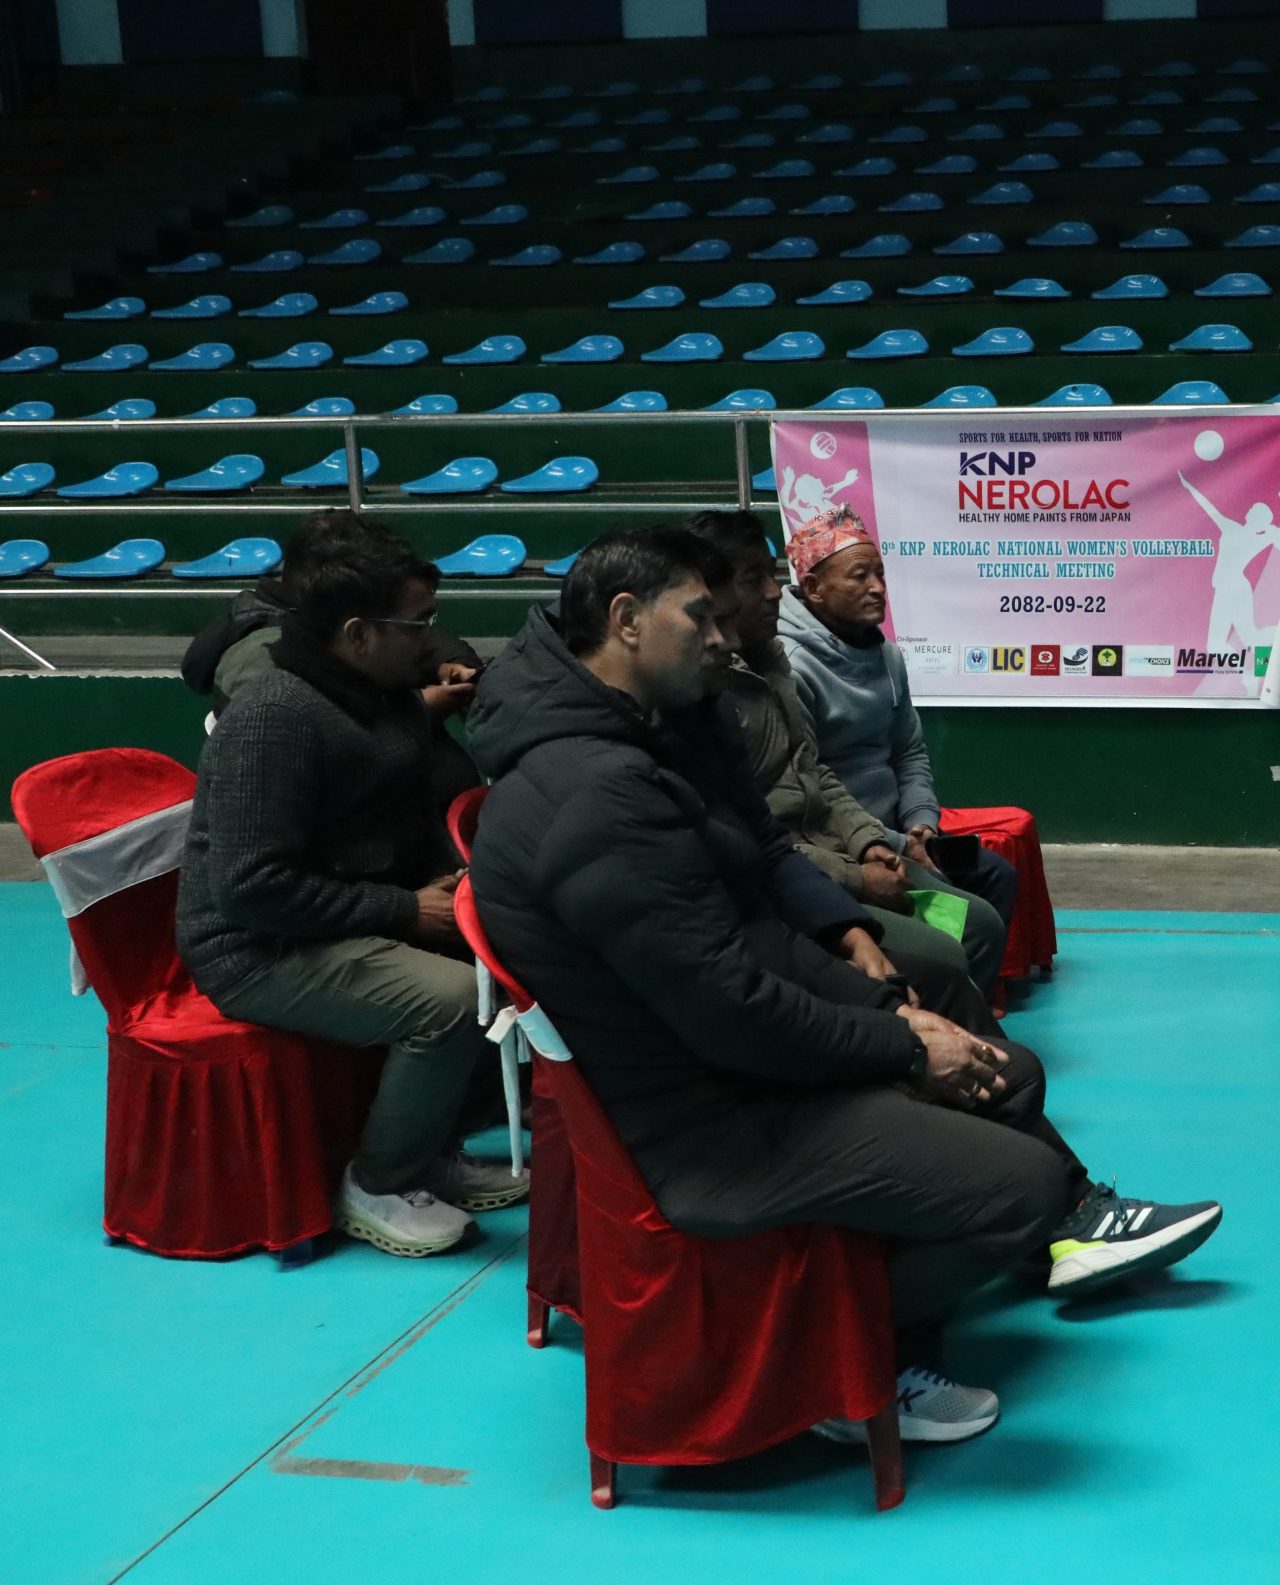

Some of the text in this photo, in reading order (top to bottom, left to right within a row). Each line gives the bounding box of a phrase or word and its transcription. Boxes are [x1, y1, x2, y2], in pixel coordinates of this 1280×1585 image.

[959, 431, 1122, 444] SPORTS FOR HEALTH, SPORTS FOR NATION
[959, 451, 1036, 476] KNP
[958, 479, 1131, 511] NEROLAC
[958, 512, 1131, 523] HEALTHY HOME PAINTS FROM JAPAN
[881, 540, 1213, 556] 9th KNP NEROLAC NATIONAL WOMEN'S VOLLEYBALL
[977, 563, 1115, 578] TECHNICAL MEETING
[1000, 596, 1106, 613] 2082-09-22
[914, 645, 952, 654] MERCURE
[992, 648, 1024, 671] LIC
[1177, 648, 1247, 668] Marvel
